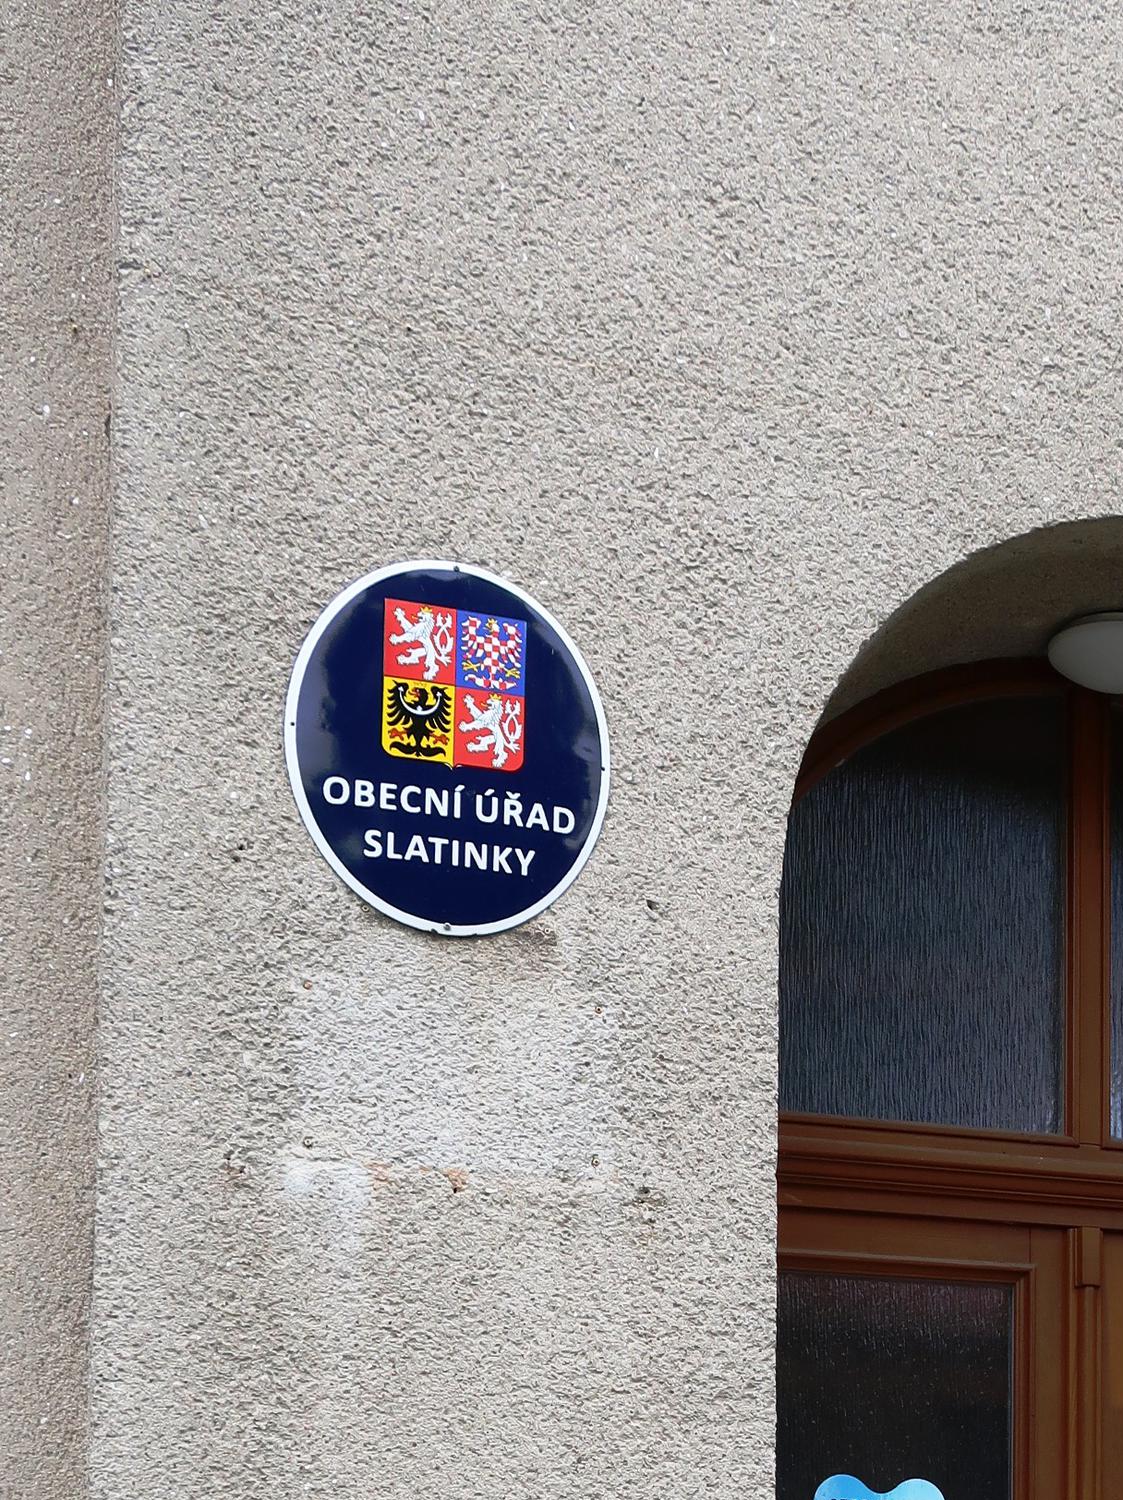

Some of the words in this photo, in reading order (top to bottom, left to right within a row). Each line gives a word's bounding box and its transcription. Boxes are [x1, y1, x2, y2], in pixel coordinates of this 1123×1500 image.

[322, 776, 466, 819] OBECNÍ
[475, 788, 576, 835] ÚŘAD
[363, 829, 536, 877] SLATINKY
